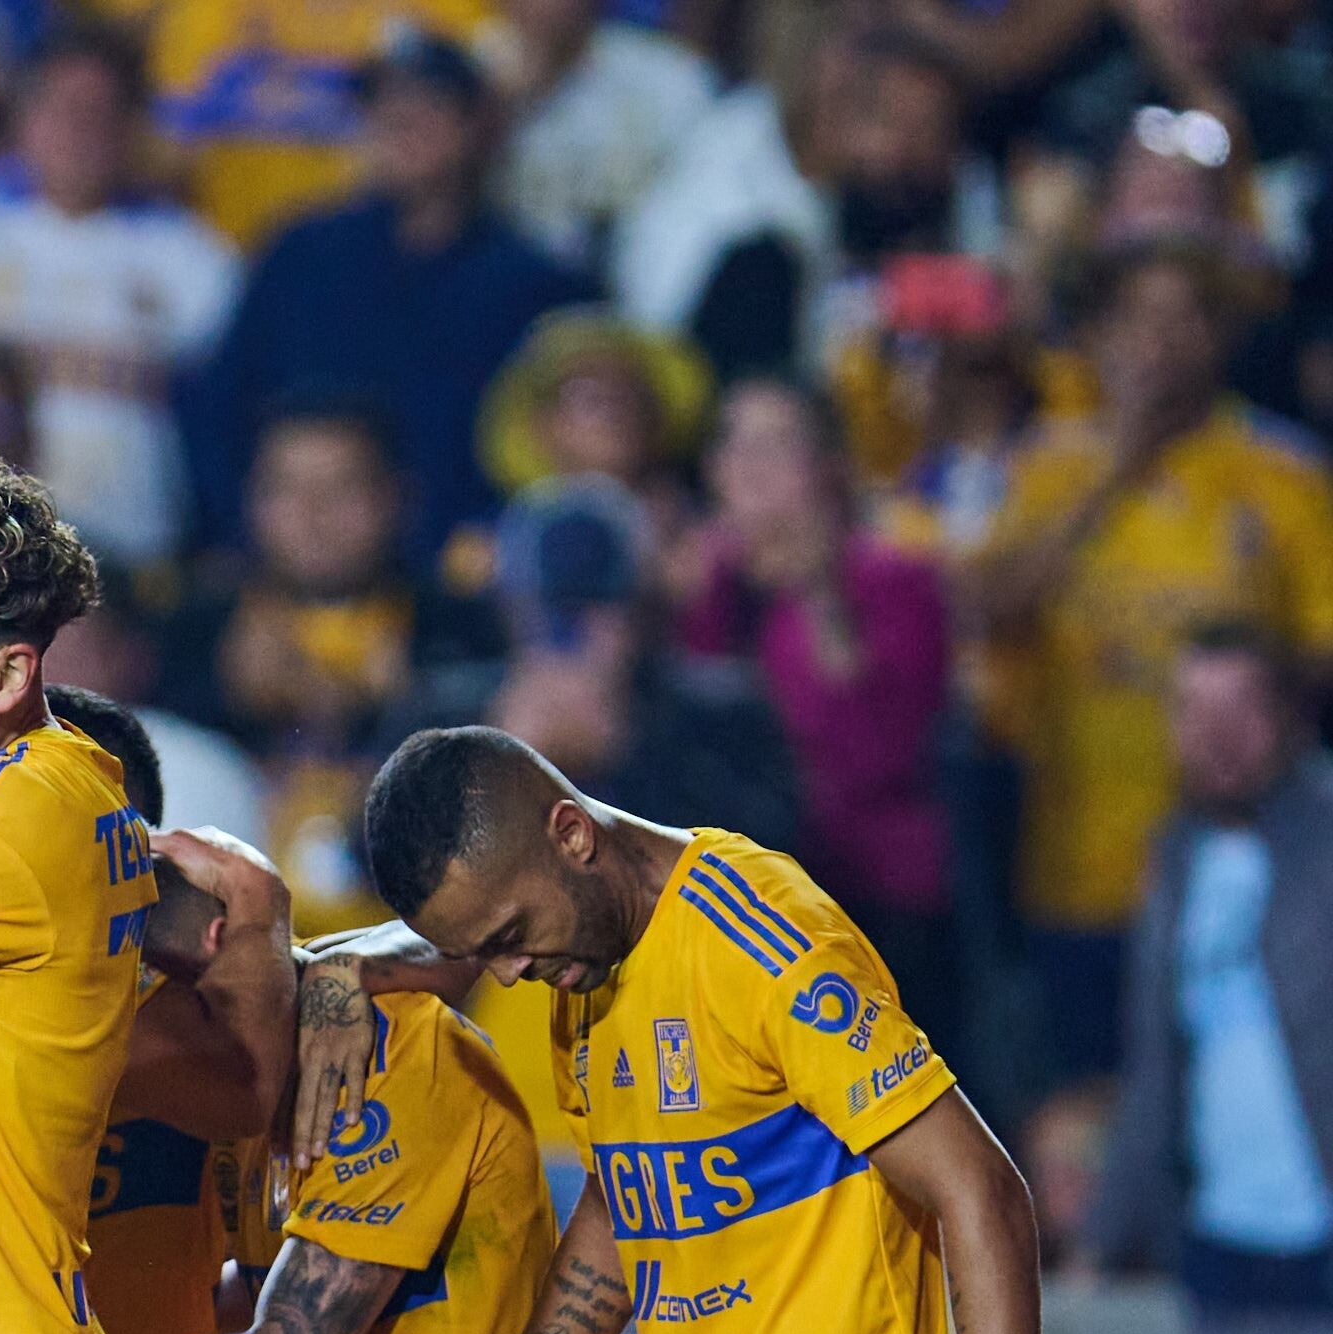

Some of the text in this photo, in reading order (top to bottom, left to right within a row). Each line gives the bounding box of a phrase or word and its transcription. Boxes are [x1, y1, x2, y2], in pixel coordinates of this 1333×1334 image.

[847, 996, 882, 1052] Berel
[871, 1036, 928, 1098] telcel
[334, 1139, 400, 1184] Berel
[655, 1278, 753, 1323] CEMEX
